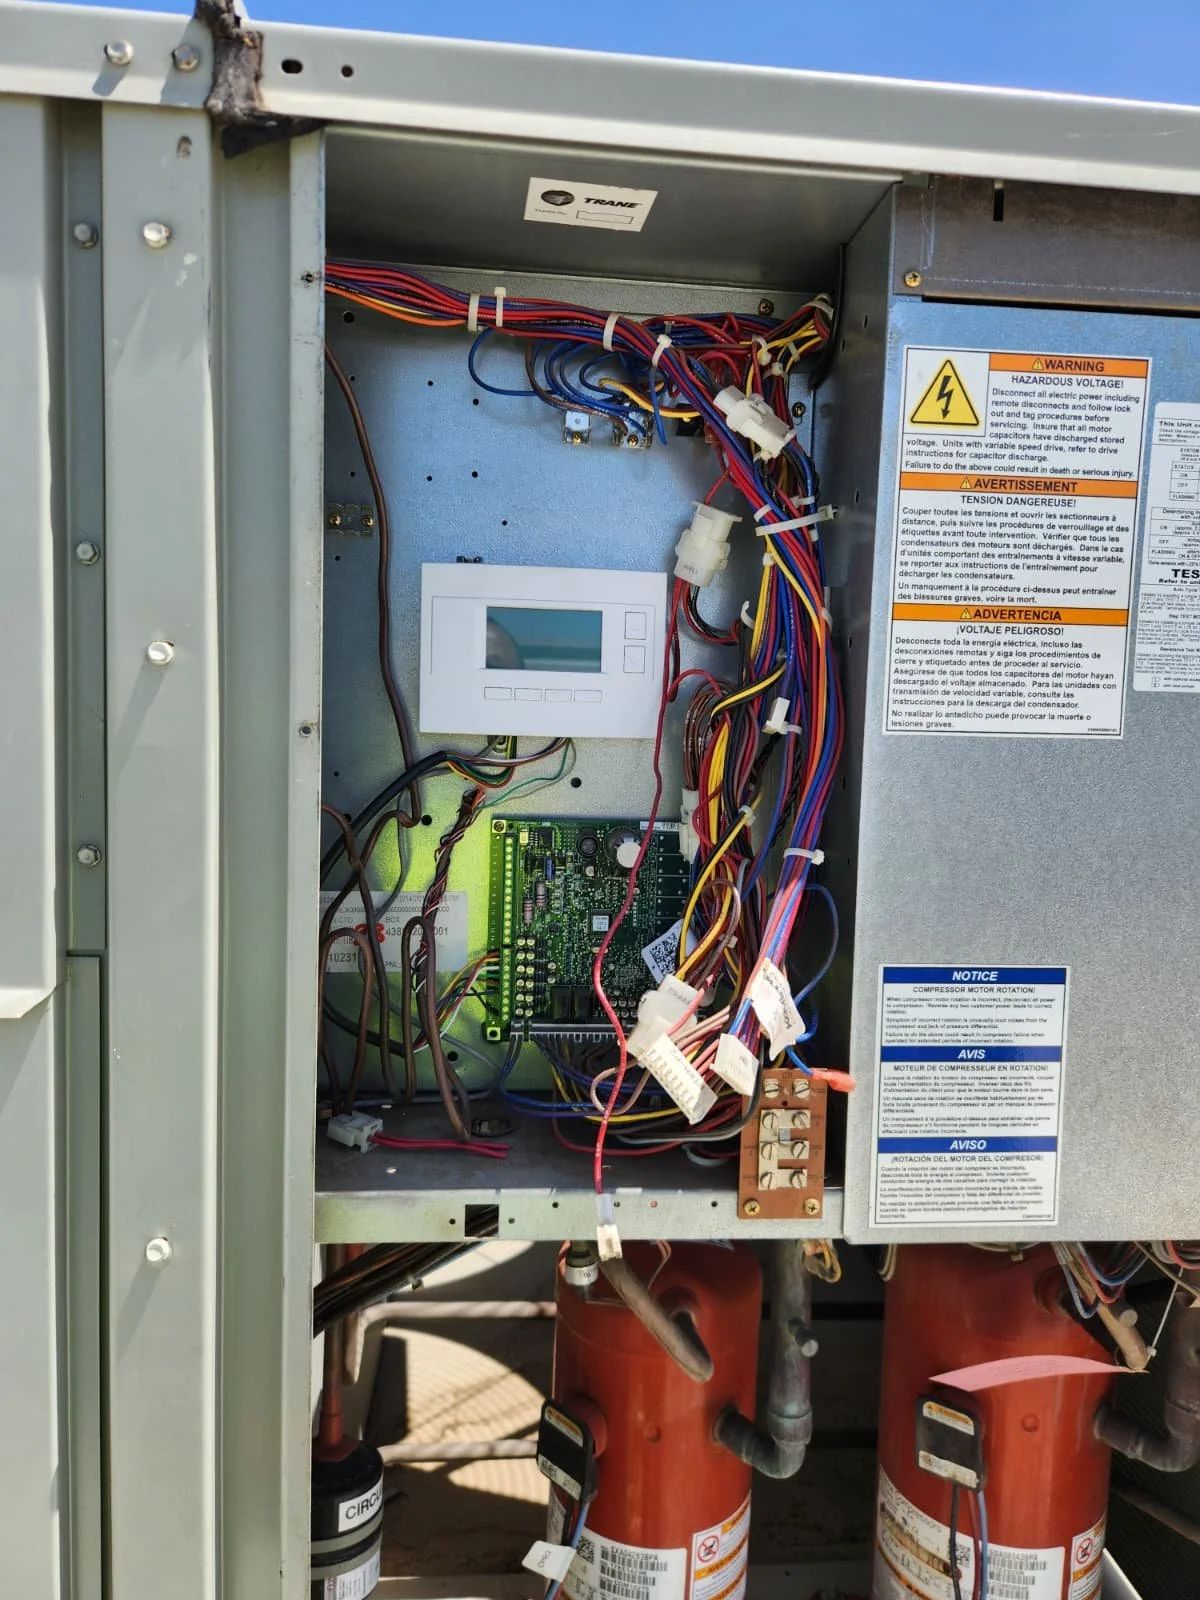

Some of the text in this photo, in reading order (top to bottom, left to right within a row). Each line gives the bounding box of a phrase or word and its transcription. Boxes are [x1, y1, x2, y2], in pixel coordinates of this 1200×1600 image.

[584, 197, 639, 209] TRANE
[1043, 359, 1104, 372] WARNING
[1011, 374, 1123, 388] HAZARDOUS VOLTAGE!
[992, 387, 1035, 397] Disconnect
[1048, 391, 1077, 399] electric
[1078, 393, 1102, 401] power
[1104, 393, 1139, 404] including
[1020, 399, 1069, 409] disconnects
[1088, 403, 1112, 411] follow
[1114, 404, 1130, 412] lock
[1022, 411, 1035, 420] tag
[1037, 412, 1082, 421] procedures
[1084, 413, 1109, 422] before
[989, 420, 1028, 430] servicing.
[1032, 421, 1058, 430] Insure
[1059, 423, 1075, 431] that
[1077, 423, 1086, 431] all
[1032, 432, 1051, 440] have
[1053, 433, 1097, 443] discharged
[906, 438, 937, 447] voltage.
[942, 439, 963, 447] Units
[964, 440, 982, 448] with
[984, 441, 1015, 449] variable
[1017, 443, 1042, 451] speed
[1043, 443, 1065, 453] drive,
[1067, 444, 1086, 452] refer
[1097, 445, 1117, 454] drive
[905, 448, 1048, 463] instructions for capacitor discharge.
[905, 460, 931, 468] Failure
[942, 461, 952, 469] do
[954, 462, 966, 470] the
[968, 463, 991, 471] above
[993, 464, 1015, 472] could
[1040, 465, 1047, 473] in
[1048, 466, 1070, 474] death
[1081, 468, 1110, 476] serious
[1111, 469, 1134, 478] injury.
[973, 478, 1078, 492] AVERTISSEMENT
[960, 495, 1076, 507] TENSION DANGEREUSE!
[902, 506, 931, 516] Couper
[960, 508, 972, 516] les
[974, 509, 1008, 517] tensions
[901, 527, 940, 536] étiquettes
[942, 529, 964, 537] avant
[988, 530, 1037, 539] intervention.
[1042, 532, 1070, 540] Vérifier
[1088, 534, 1106, 542] tous
[898, 569, 938, 579] décharger
[953, 571, 1014, 579] condensateurs.
[913, 592, 952, 600] blessures
[954, 595, 983, 603] graves,
[985, 594, 1005, 602] voire
[972, 609, 1061, 620] ADVERTENCIA
[956, 624, 1063, 635] ¡VOLTAJE PELIGROSO!
[895, 636, 941, 645] Desconecte
[943, 637, 960, 645] toda
[971, 638, 1001, 647] energía
[1040, 640, 1069, 648] incluso
[894, 647, 953, 655] desconexiones
[955, 648, 987, 656] remotas
[996, 649, 1013, 658] siga
[1015, 649, 1027, 657] los
[1028, 650, 1089, 659] procedimientos
[925, 658, 967, 666] etiquetado
[1004, 660, 1039, 668] proceder
[892, 677, 938, 686] descargado
[949, 679, 976, 687] voltaje
[977, 678, 1026, 687] almacenado.
[1051, 680, 1062, 688] las
[892, 697, 945, 705] instrucciones
[975, 699, 1011, 708] descarga
[1013, 699, 1025, 707] del
[1027, 700, 1079, 708] condensador.
[953, 970, 998, 980] NOTICE
[958, 1049, 985, 1059] AVIS
[950, 1140, 986, 1149] AVISO
